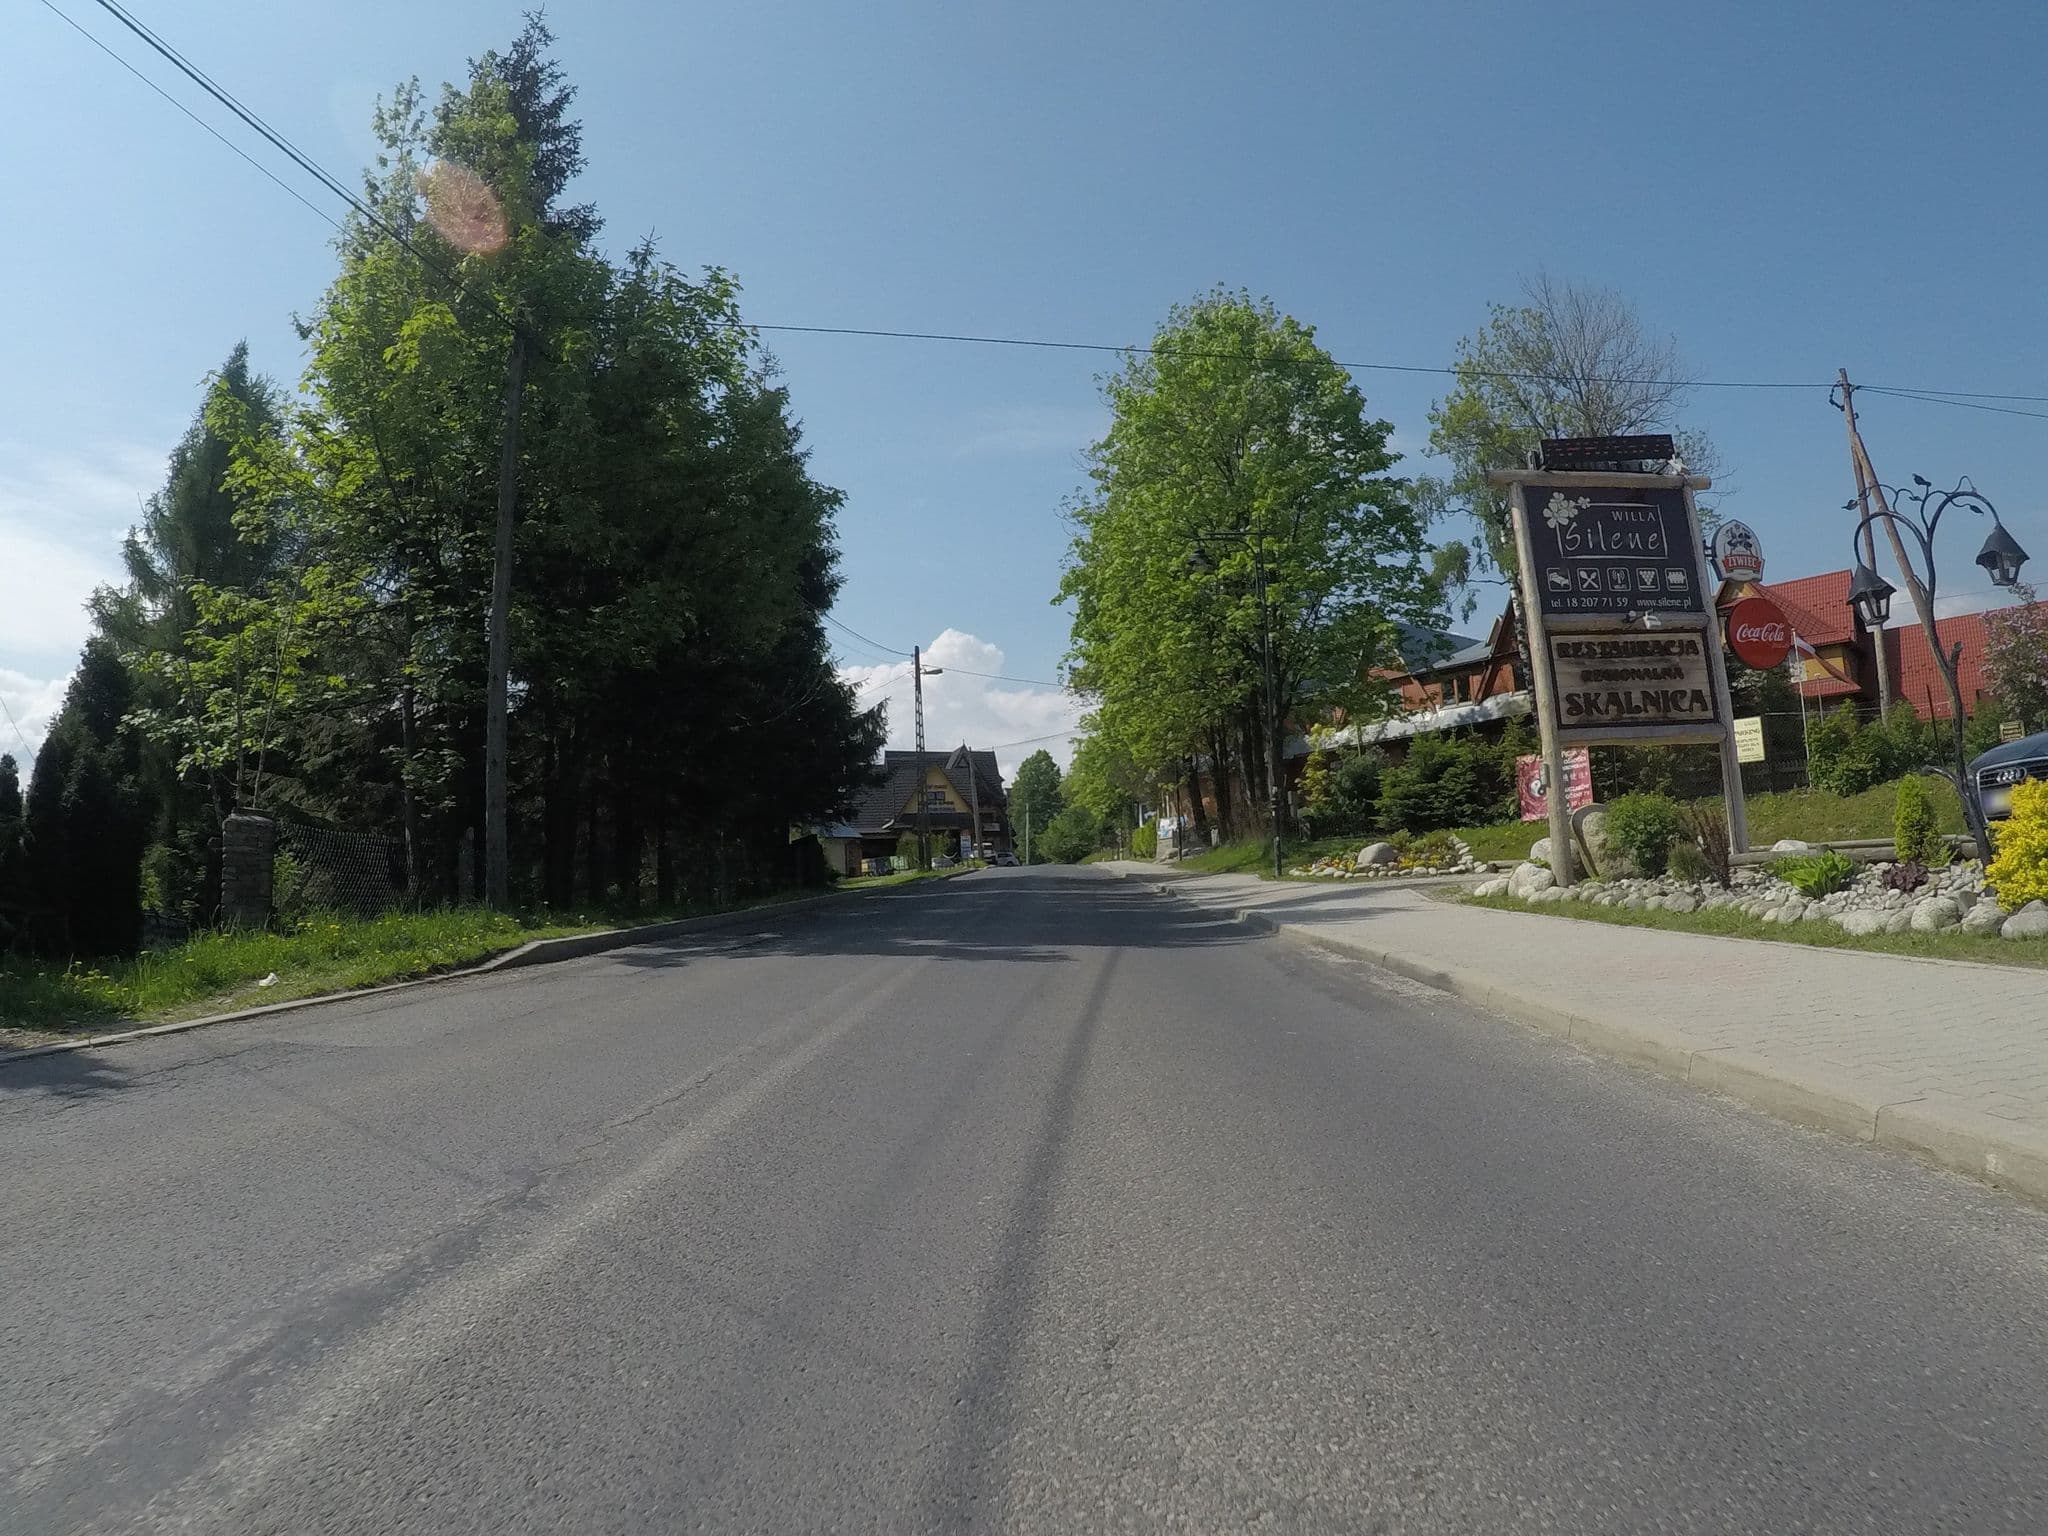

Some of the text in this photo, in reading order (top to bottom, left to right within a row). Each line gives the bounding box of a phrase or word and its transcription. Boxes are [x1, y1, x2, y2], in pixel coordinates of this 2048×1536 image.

[1611, 510, 1657, 522] WILLA
[1565, 521, 1661, 551] Silene
[1566, 598, 1578, 608] 18
[1581, 598, 1599, 608] 207
[1602, 598, 1613, 607] 71
[1616, 597, 1629, 607] 59
[1636, 597, 1692, 609] www.silene.pl
[1565, 689, 1709, 717] SKALNICA
